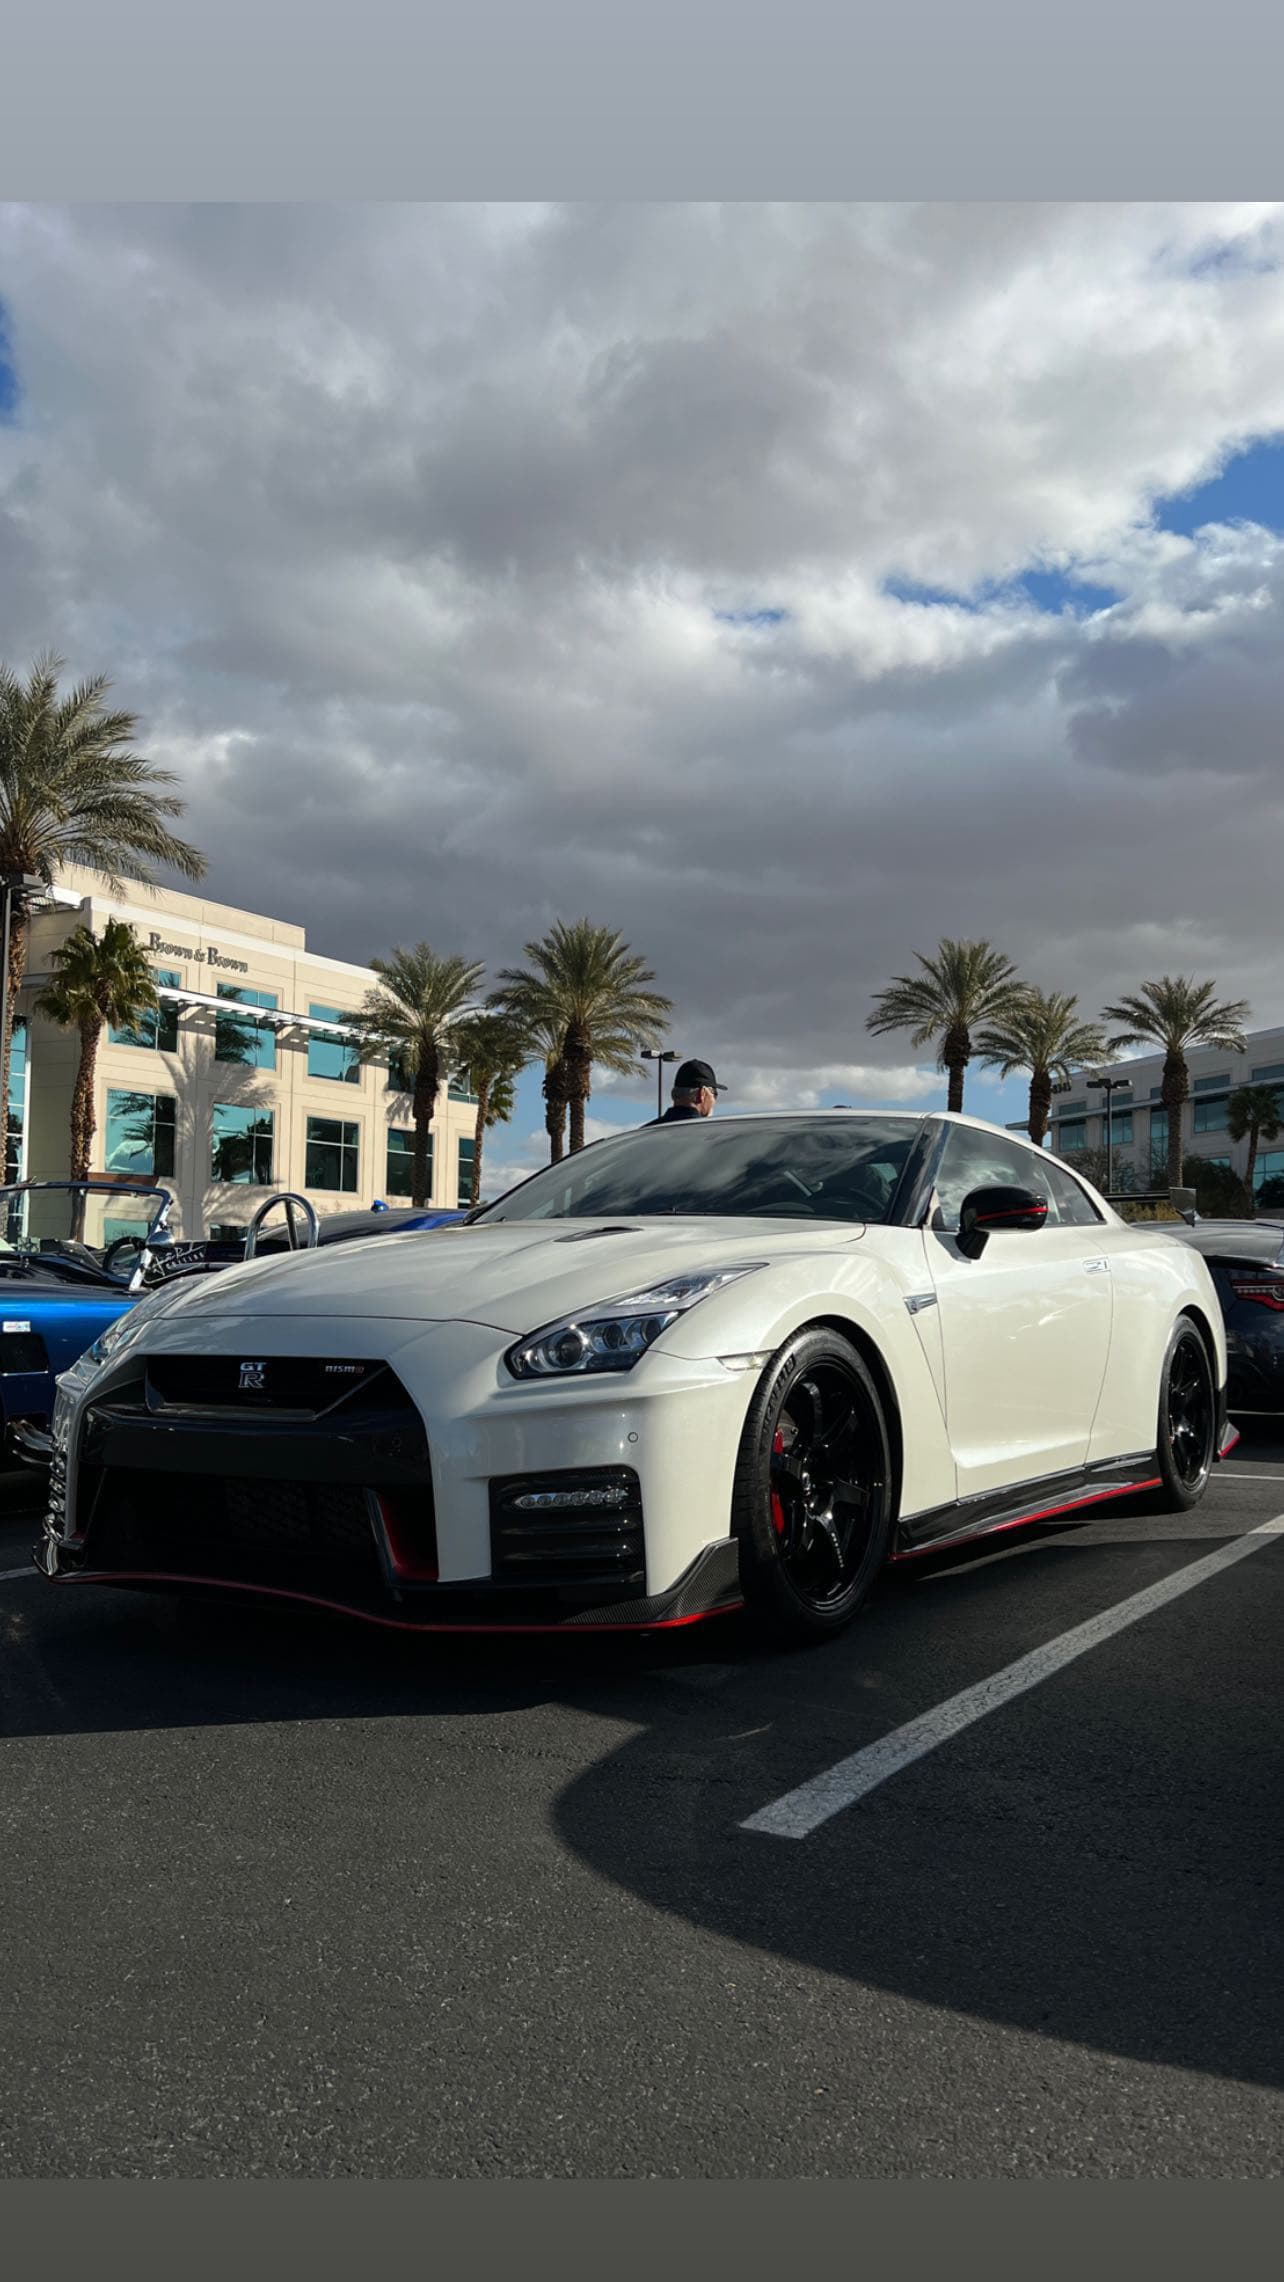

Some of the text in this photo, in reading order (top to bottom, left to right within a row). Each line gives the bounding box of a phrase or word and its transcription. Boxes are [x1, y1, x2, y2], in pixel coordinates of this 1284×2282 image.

[149, 932, 248, 973] Brown & Brown
[240, 1362, 267, 1371] GT
